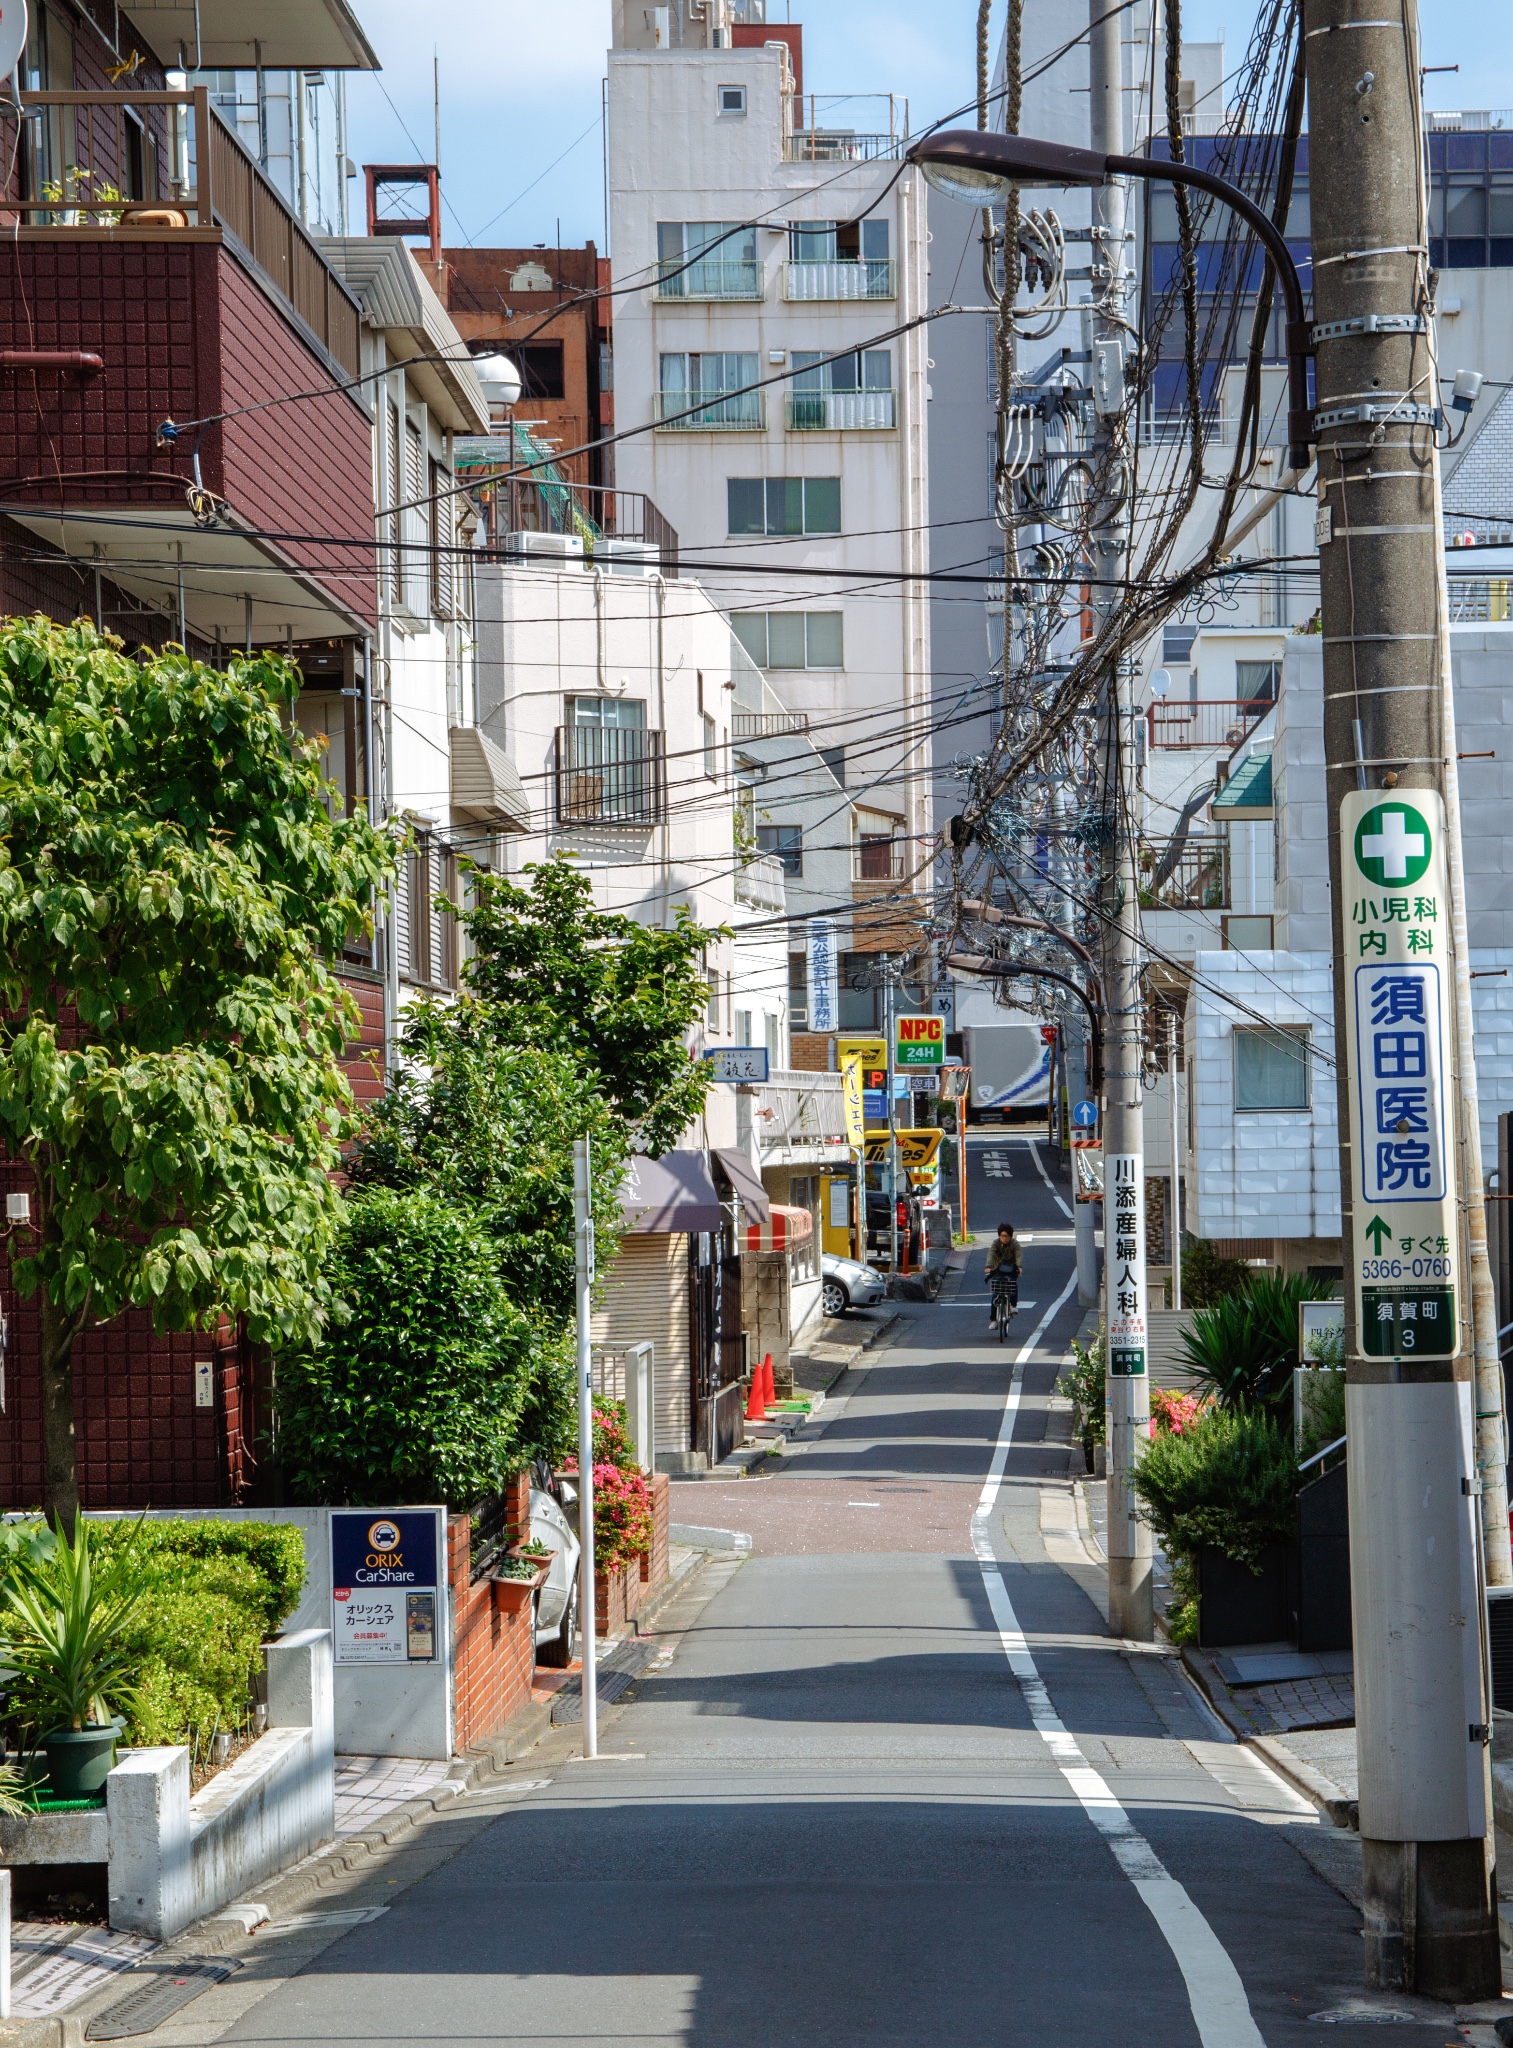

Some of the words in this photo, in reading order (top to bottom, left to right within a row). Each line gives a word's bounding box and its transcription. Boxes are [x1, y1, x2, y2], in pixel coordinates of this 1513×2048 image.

[1352, 897, 1438, 925] 小児科
[1360, 930, 1434, 956] 内科
[900, 1019, 941, 1040] NPC
[907, 1047, 934, 1058] 24H
[871, 1071, 884, 1088] P
[911, 1078, 934, 1088] 空車
[1370, 975, 1432, 1192] 須田医院
[865, 1145, 926, 1161] Ties
[982, 1151, 1013, 1177] 止まれ
[1115, 1159, 1139, 1315] 川添産婦人科
[1399, 1236, 1450, 1255] すぐ先
[1362, 1258, 1452, 1280] 5366-0760
[1377, 1301, 1438, 1321] 須賀町
[1110, 1335, 1145, 1345] 3351-2315
[1402, 1329, 1415, 1348] 3
[1126, 1364, 1132, 1372] 3
[365, 1554, 404, 1568] ORIX
[355, 1569, 415, 1582] CarShare
[346, 1604, 393, 1614] オリックス
[346, 1615, 394, 1626] カーシェア
[353, 1632, 388, 1640] 会員募集中!
